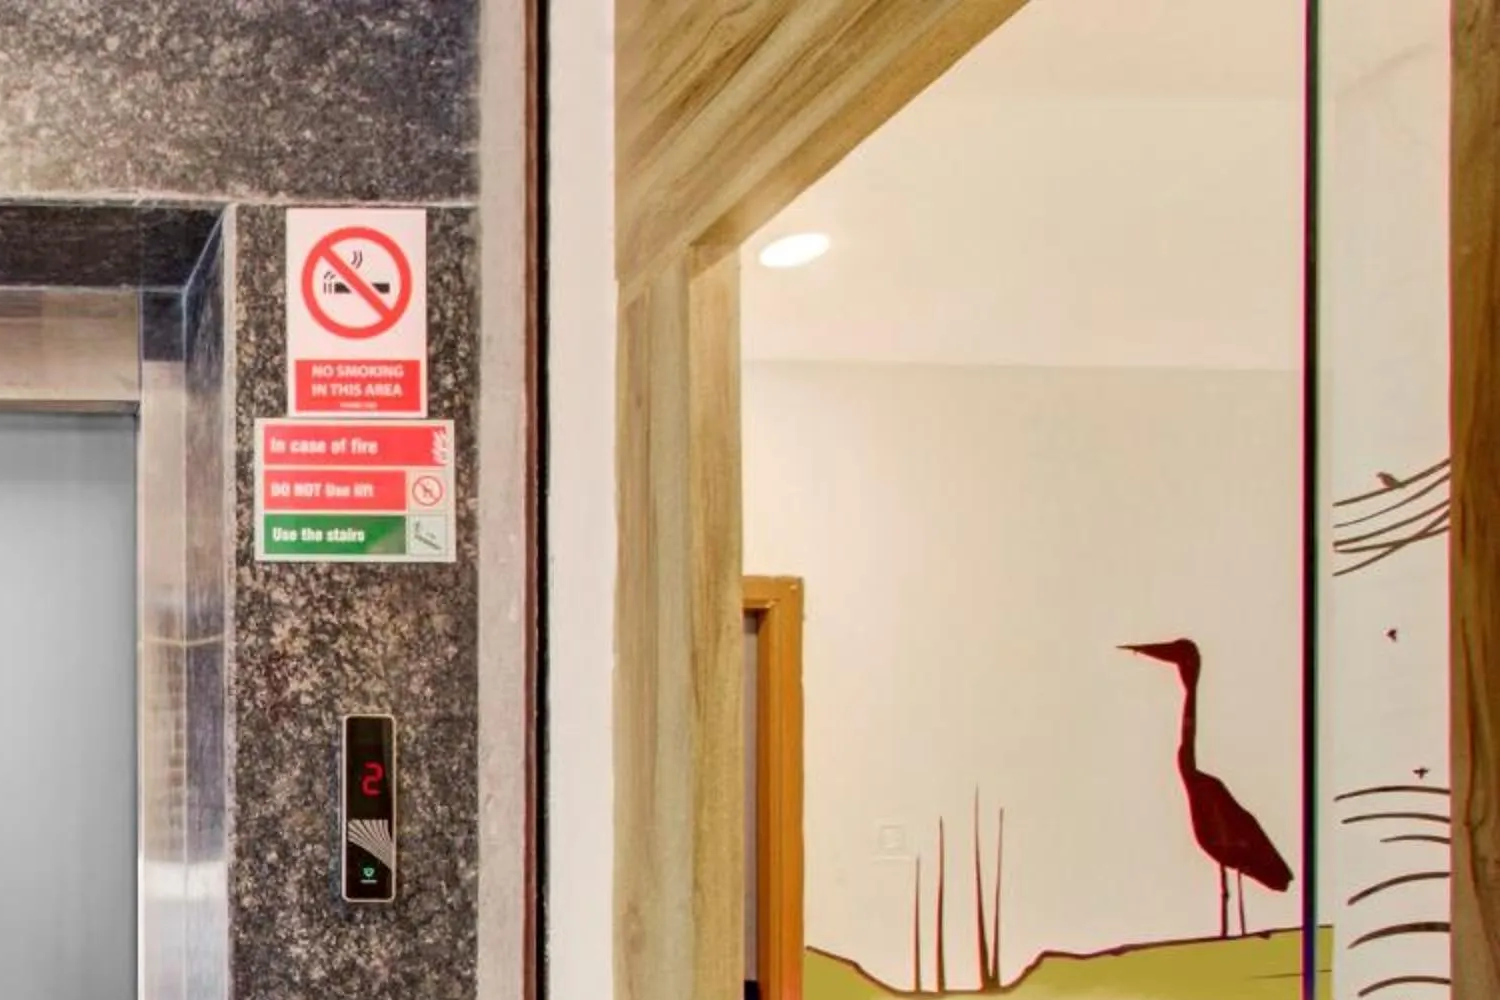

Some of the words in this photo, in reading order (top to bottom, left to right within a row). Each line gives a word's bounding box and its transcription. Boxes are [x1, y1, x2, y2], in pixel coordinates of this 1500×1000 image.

[312, 364, 334, 378] NO
[336, 364, 404, 378] SMOKING
[311, 383, 327, 397] IN
[330, 383, 362, 397] THIS
[365, 383, 403, 397] AREA
[270, 437, 285, 453] In
[290, 440, 326, 454] case
[331, 438, 348, 454] of
[351, 437, 378, 454] fire
[271, 482, 290, 497] DO
[294, 482, 322, 497] NOT
[272, 528, 297, 542] Use
[301, 528, 323, 542] the
[327, 528, 365, 542] stairs
[361, 761, 384, 796] 2
